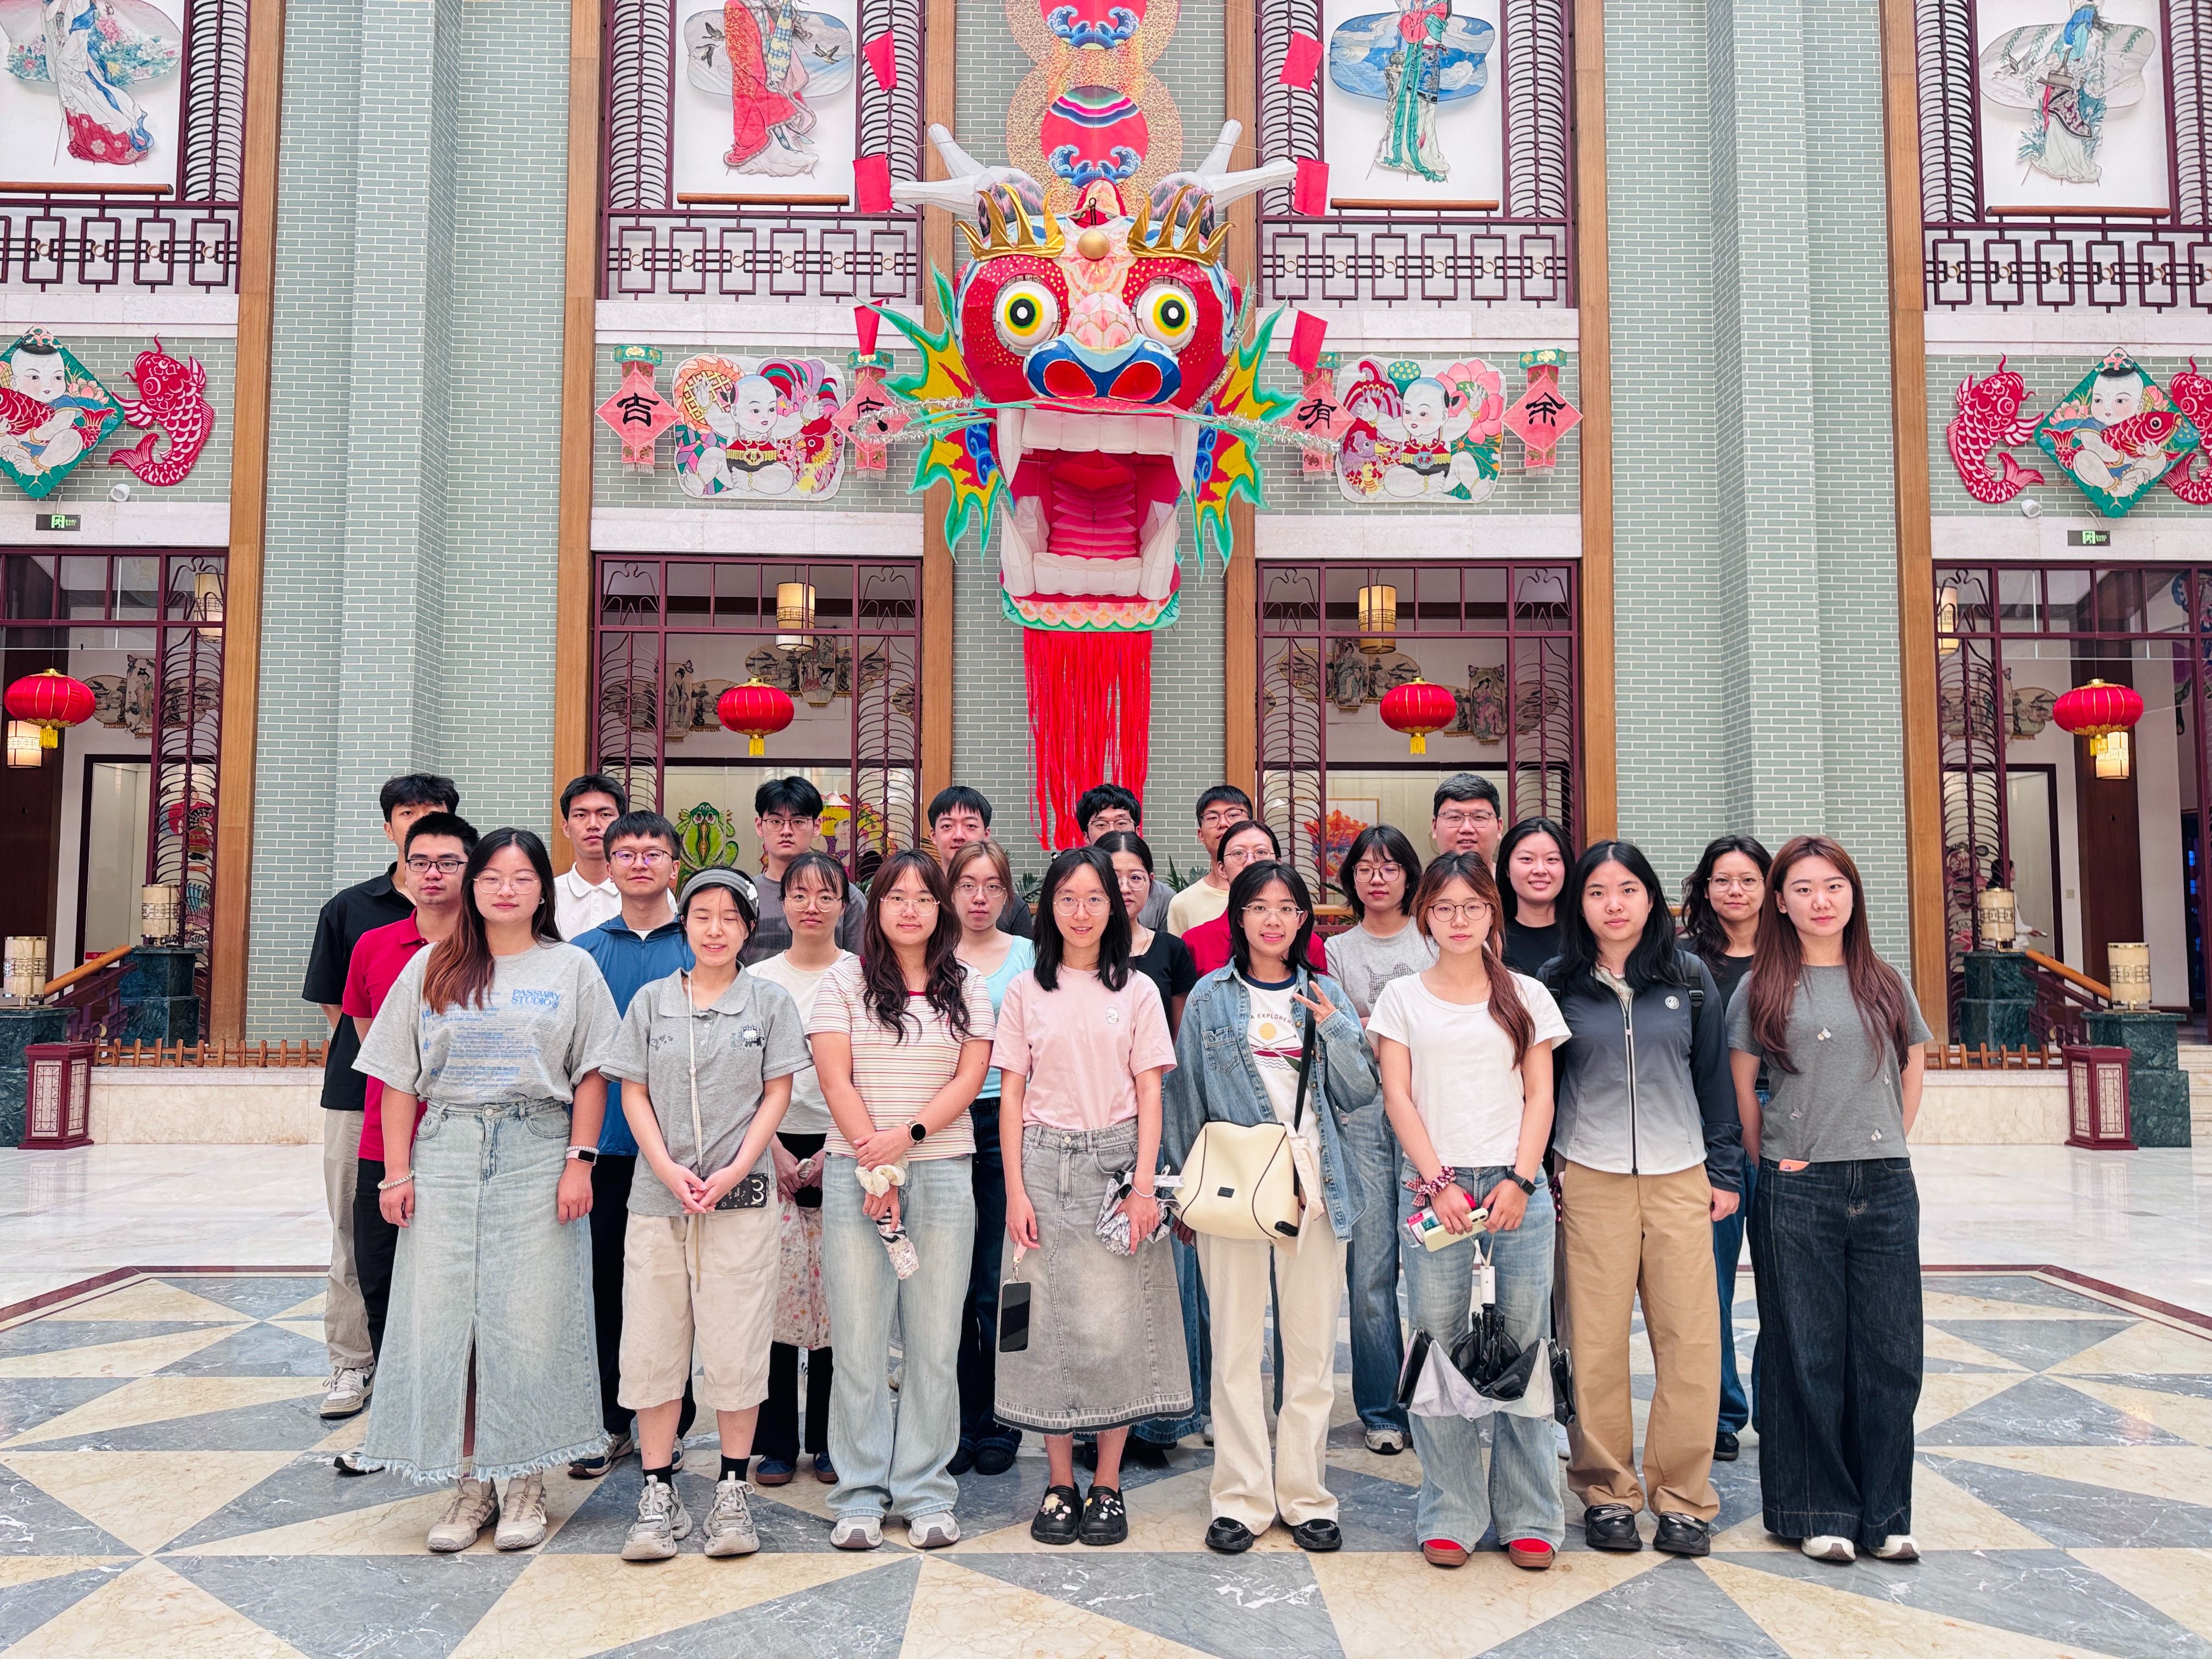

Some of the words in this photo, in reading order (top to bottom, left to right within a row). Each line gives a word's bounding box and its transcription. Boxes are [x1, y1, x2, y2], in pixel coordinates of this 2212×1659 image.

[617, 392, 659, 427] 吉
[1297, 398, 1338, 430] 有
[1526, 392, 1566, 427] 余
[512, 989, 561, 1000] PASSWAY
